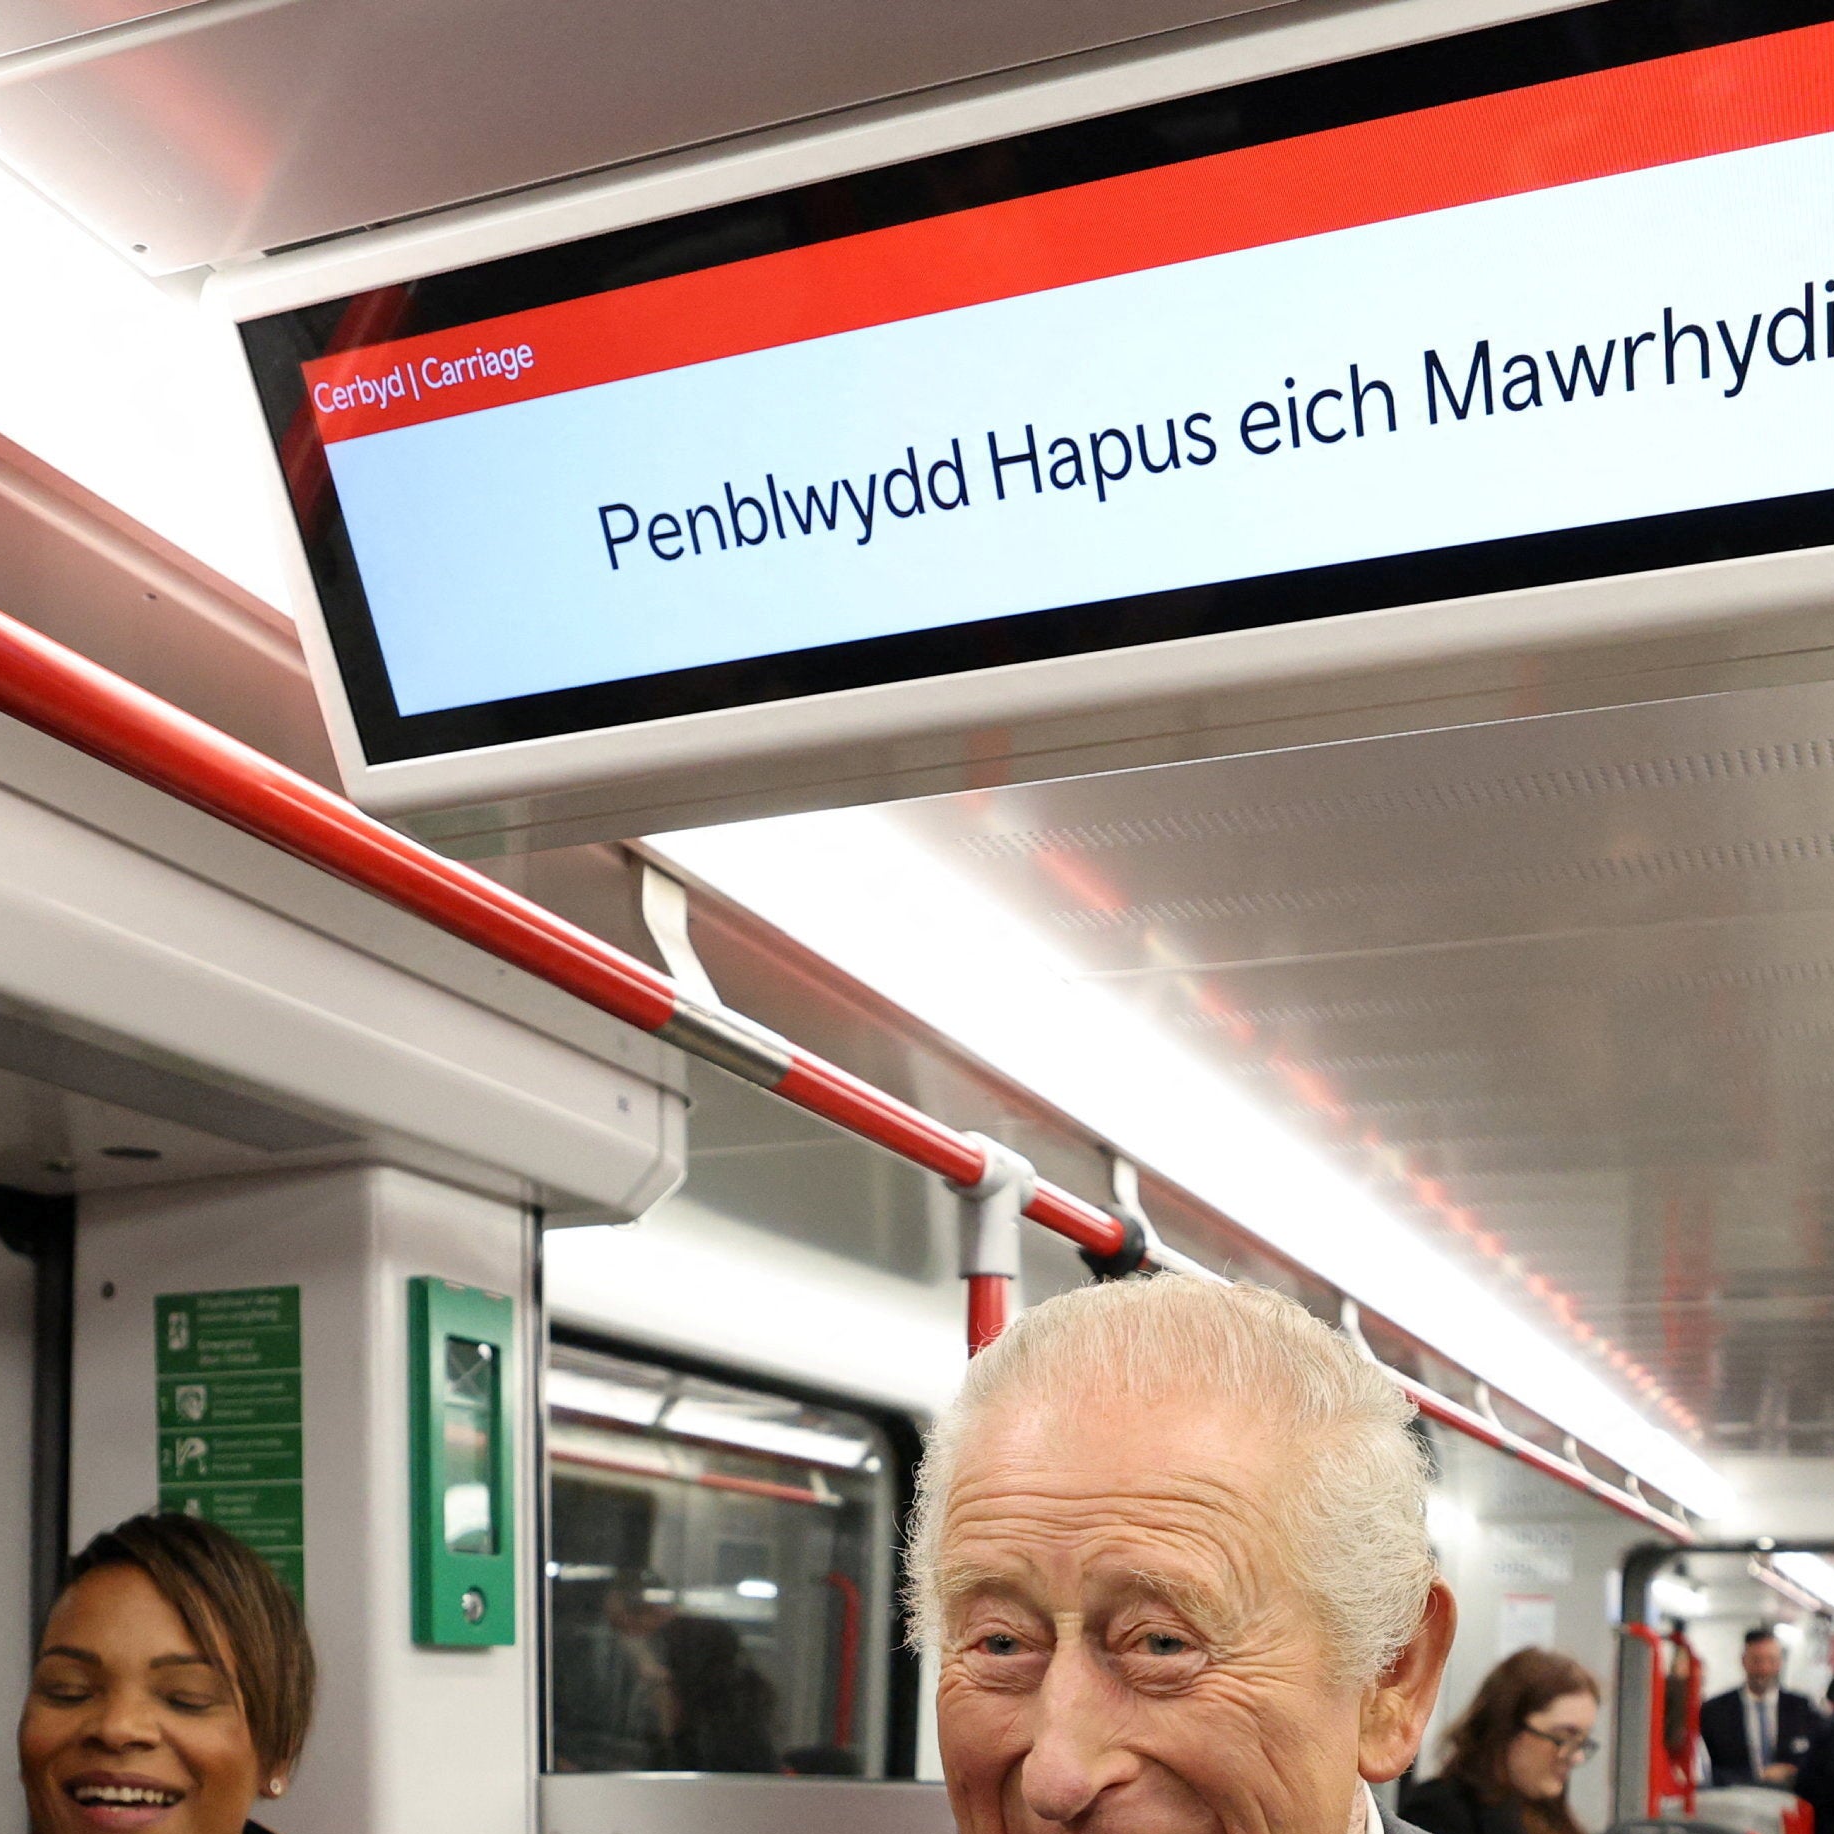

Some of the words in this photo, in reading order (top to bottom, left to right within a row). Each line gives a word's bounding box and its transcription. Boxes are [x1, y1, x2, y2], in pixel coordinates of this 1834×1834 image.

[313, 365, 406, 414] Cerbyd
[421, 343, 535, 390] Carriage
[598, 437, 971, 571] Penblwydd
[987, 411, 1218, 503] Hapus
[1239, 362, 1398, 456] eich
